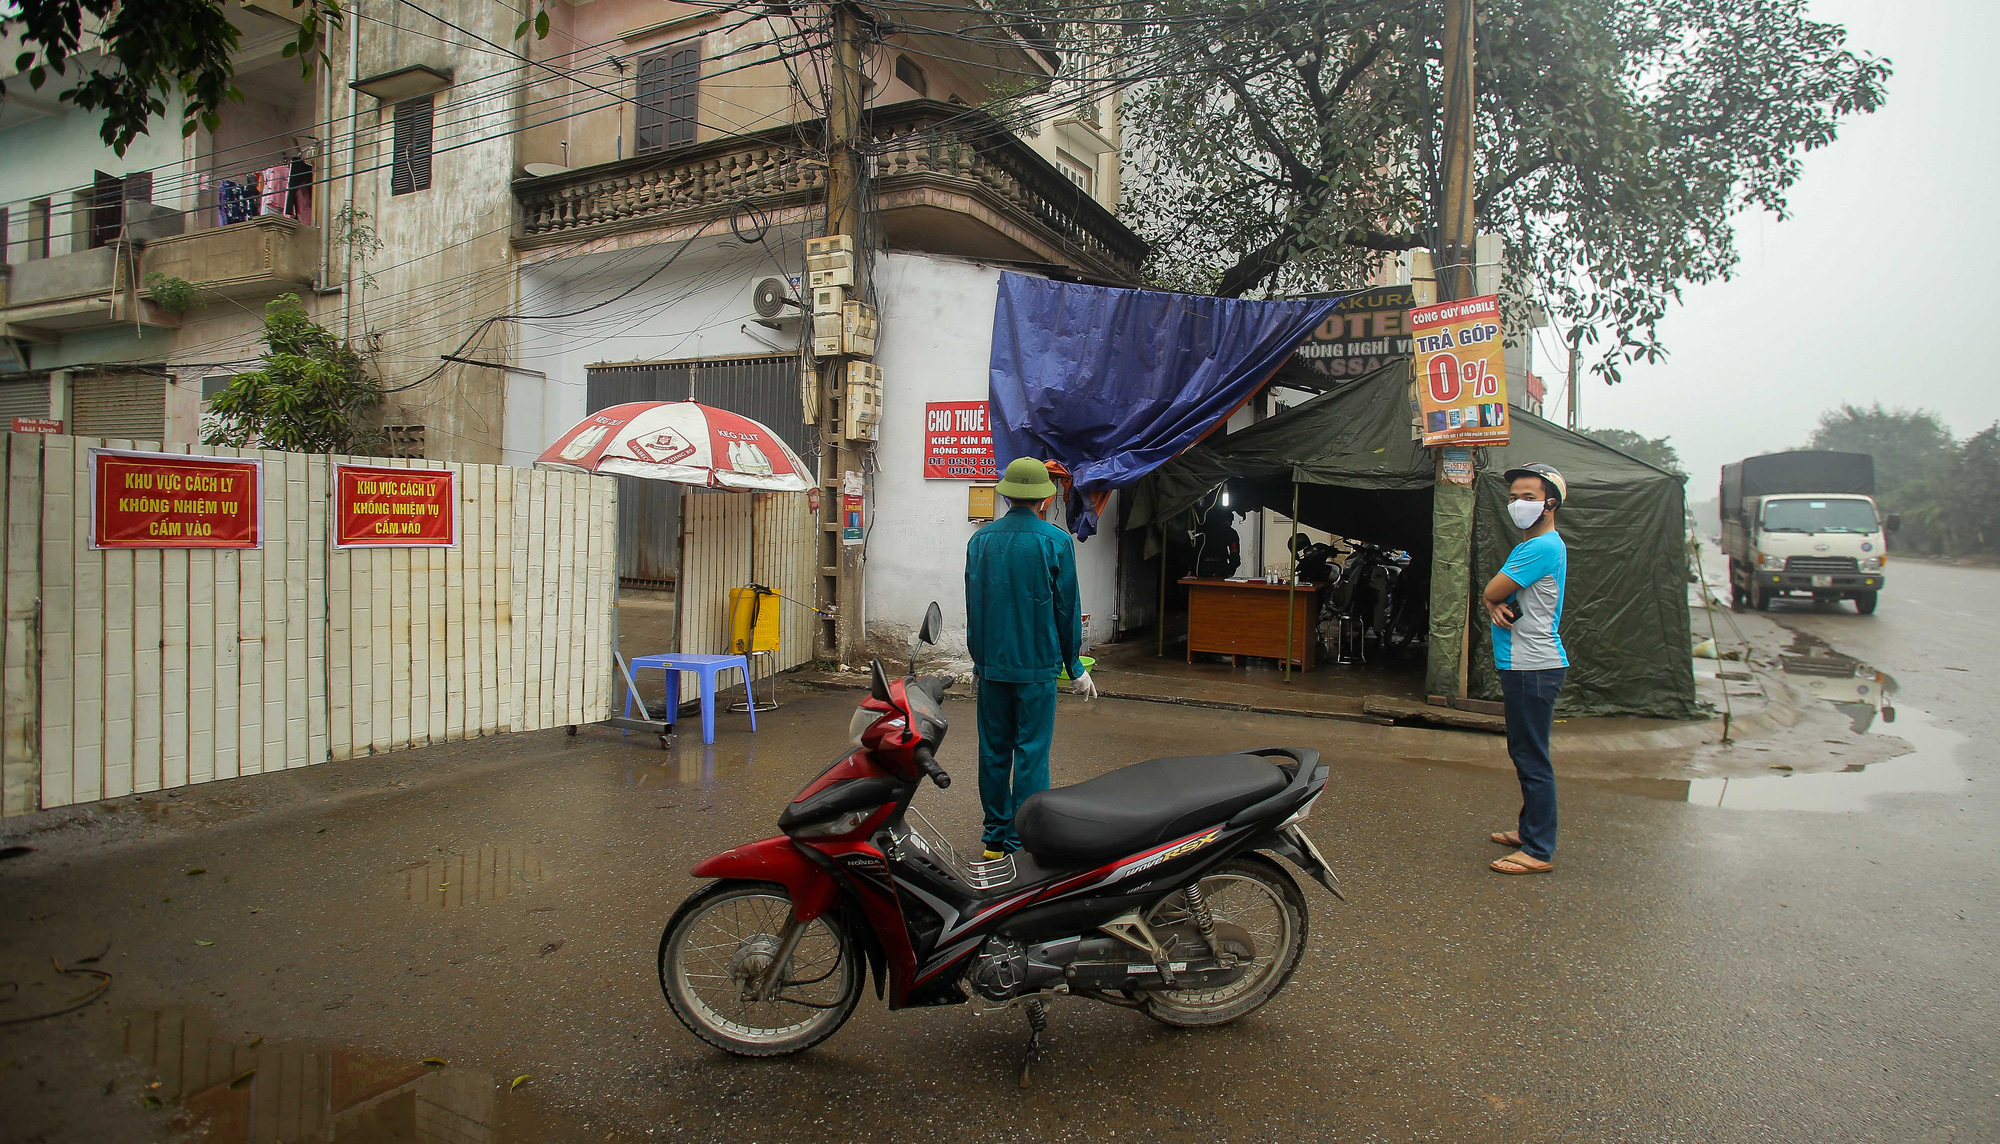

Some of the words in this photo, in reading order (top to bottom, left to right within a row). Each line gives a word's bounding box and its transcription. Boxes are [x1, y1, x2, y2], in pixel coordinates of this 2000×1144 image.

[1336, 293, 1415, 310] AKURA
[1413, 311, 1438, 325] CÔNG
[1461, 301, 1495, 316] MOBILE
[1306, 310, 1413, 341] OTE
[1415, 326, 1455, 354] TRẢ
[1458, 322, 1498, 347] GÓP
[1297, 341, 1344, 359] HÒNG
[1347, 336, 1390, 356] NGHỈ
[1427, 352, 1498, 403] 0%
[928, 409, 952, 432] CHO
[954, 404, 985, 432] THUÊ
[717, 429, 738, 439] KEG
[738, 432, 759, 441] 2LIT
[931, 435, 958, 445] KHÉP
[960, 434, 979, 445] KÍN
[631, 445, 652, 462] HABEC
[932, 446, 959, 456] RỘNG
[960, 447, 987, 455] 30M2
[928, 457, 946, 466] ĐT:
[948, 457, 977, 466] 0913
[948, 467, 977, 475] 0904
[125, 473, 152, 490] KHU
[157, 473, 181, 494] VỰC
[185, 472, 217, 493] CÁCH
[220, 477, 234, 493] LY
[357, 480, 377, 495] KHU
[379, 480, 398, 498] VỰC
[400, 480, 424, 497] CÁCH
[426, 483, 436, 497] LY
[119, 496, 170, 513] KHÔNG
[173, 498, 218, 517] NHIỆM
[221, 501, 238, 518] VỤ
[353, 500, 390, 515] KHÔNG
[392, 501, 425, 518] NHIỆM
[427, 503, 439, 518] VỤ
[150, 517, 181, 536] CẤM
[185, 520, 212, 536] VÀO
[375, 518, 399, 534] CẤM
[401, 520, 421, 534] VÀO
[1163, 829, 1220, 862] RSX
